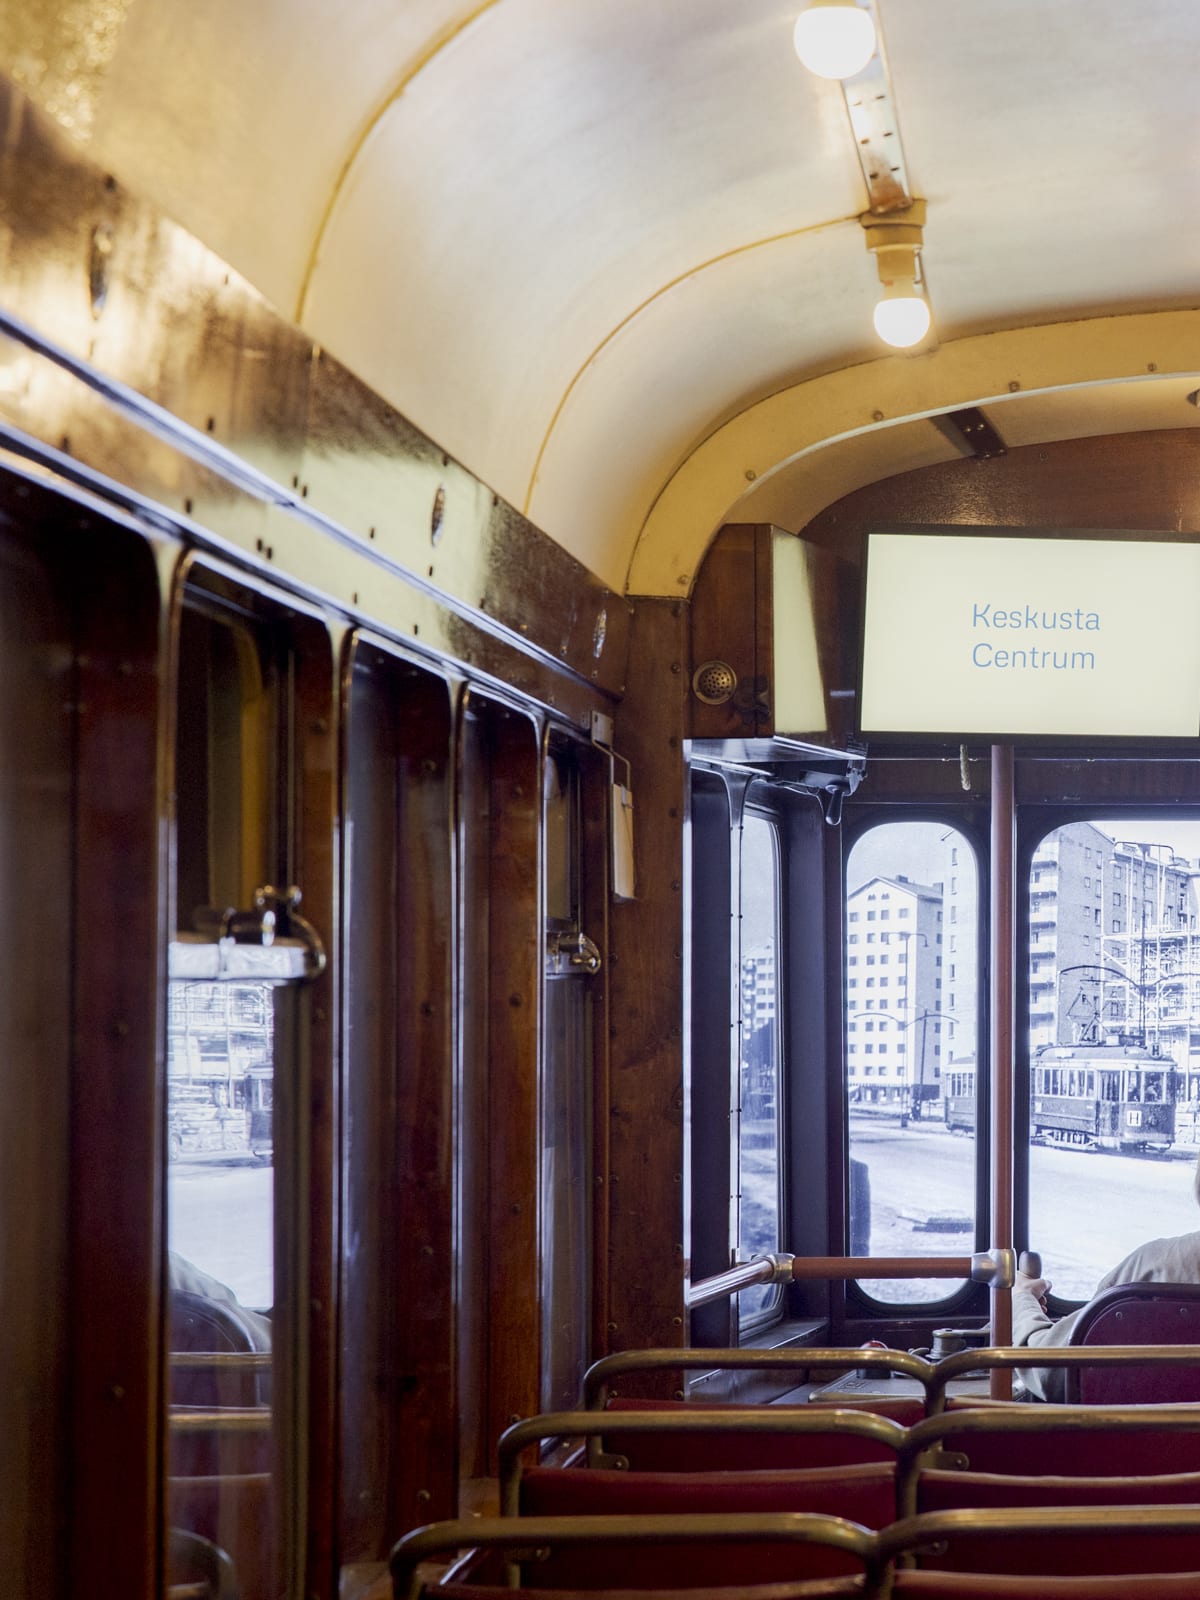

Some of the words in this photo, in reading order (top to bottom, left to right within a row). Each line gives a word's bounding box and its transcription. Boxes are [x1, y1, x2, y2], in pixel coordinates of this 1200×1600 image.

[973, 604, 1101, 631] Keskusta
[972, 643, 1096, 670] Centrum
[1129, 1113, 1139, 1125] H
